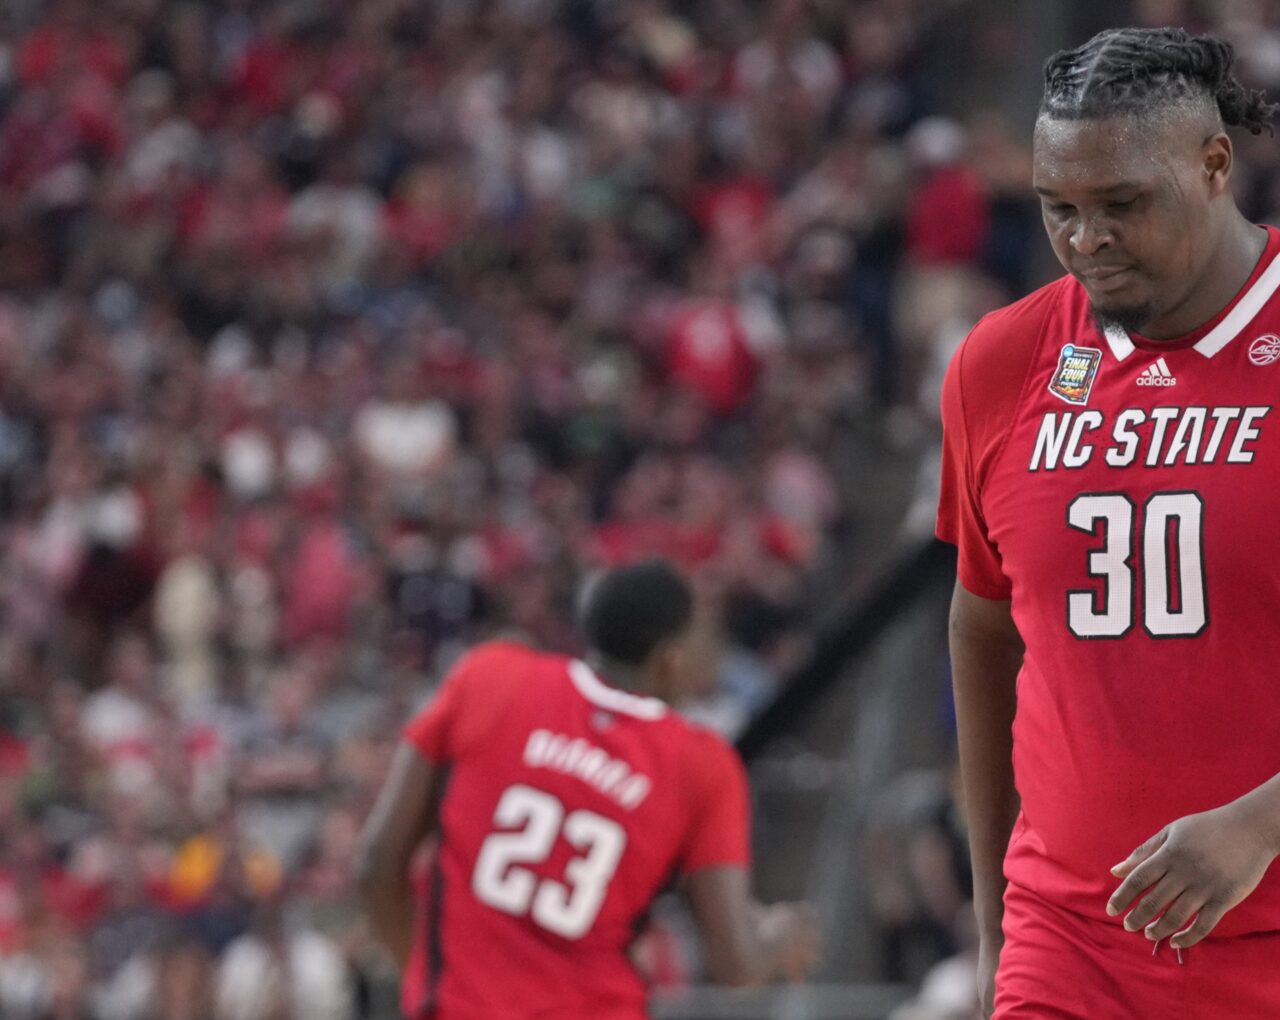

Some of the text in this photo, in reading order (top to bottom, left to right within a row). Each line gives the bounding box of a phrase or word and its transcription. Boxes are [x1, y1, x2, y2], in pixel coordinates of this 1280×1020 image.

[1060, 368, 1087, 384] FOUR
[1063, 357, 1091, 370] FINAL
[1136, 376, 1177, 387] adidas
[1028, 406, 1273, 472] NC STATE
[1066, 489, 1210, 640] 30
[471, 783, 628, 940] 23
